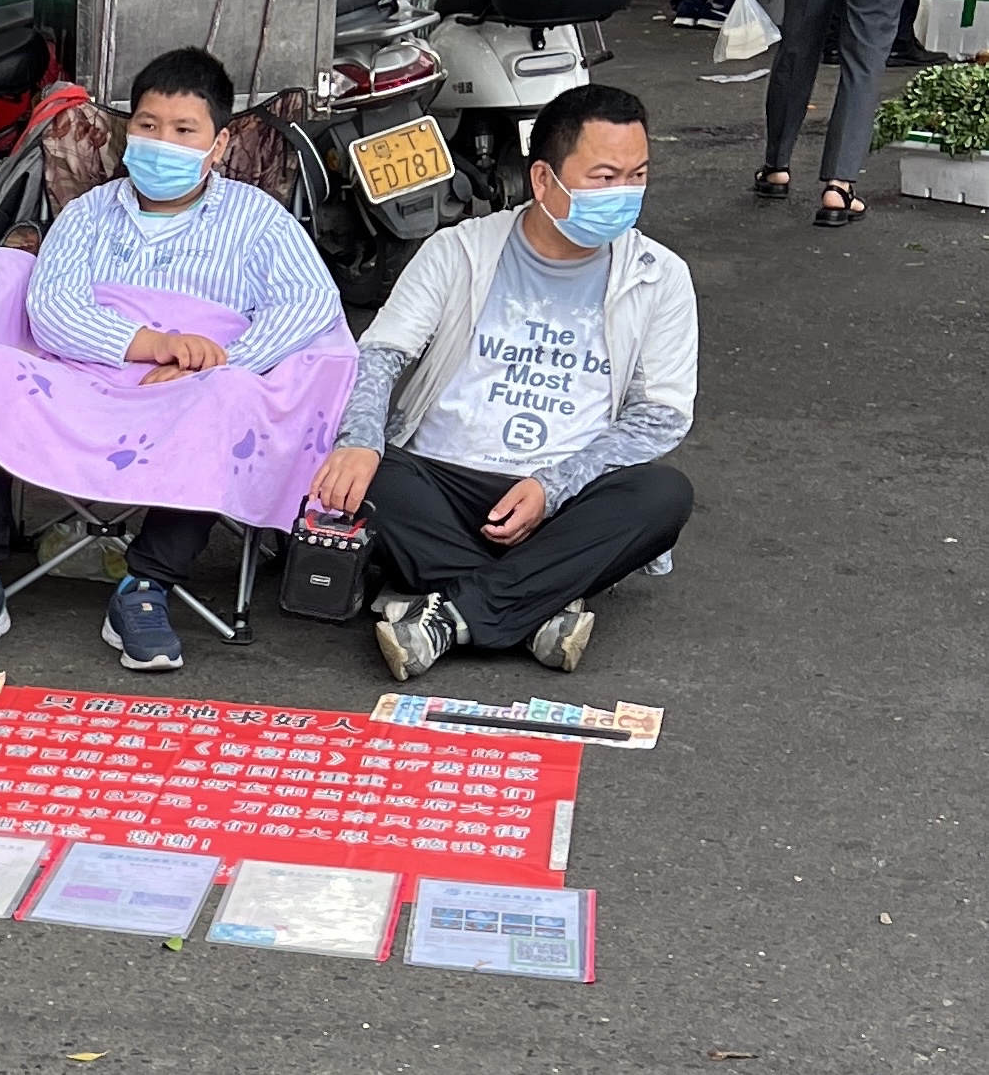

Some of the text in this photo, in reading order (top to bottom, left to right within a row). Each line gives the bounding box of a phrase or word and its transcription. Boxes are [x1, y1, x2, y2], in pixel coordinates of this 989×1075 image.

[369, 147, 441, 194] FD787
[525, 320, 575, 346] The
[478, 334, 611, 375] Want to be
[504, 363, 573, 392] Most
[488, 382, 576, 415] Future
